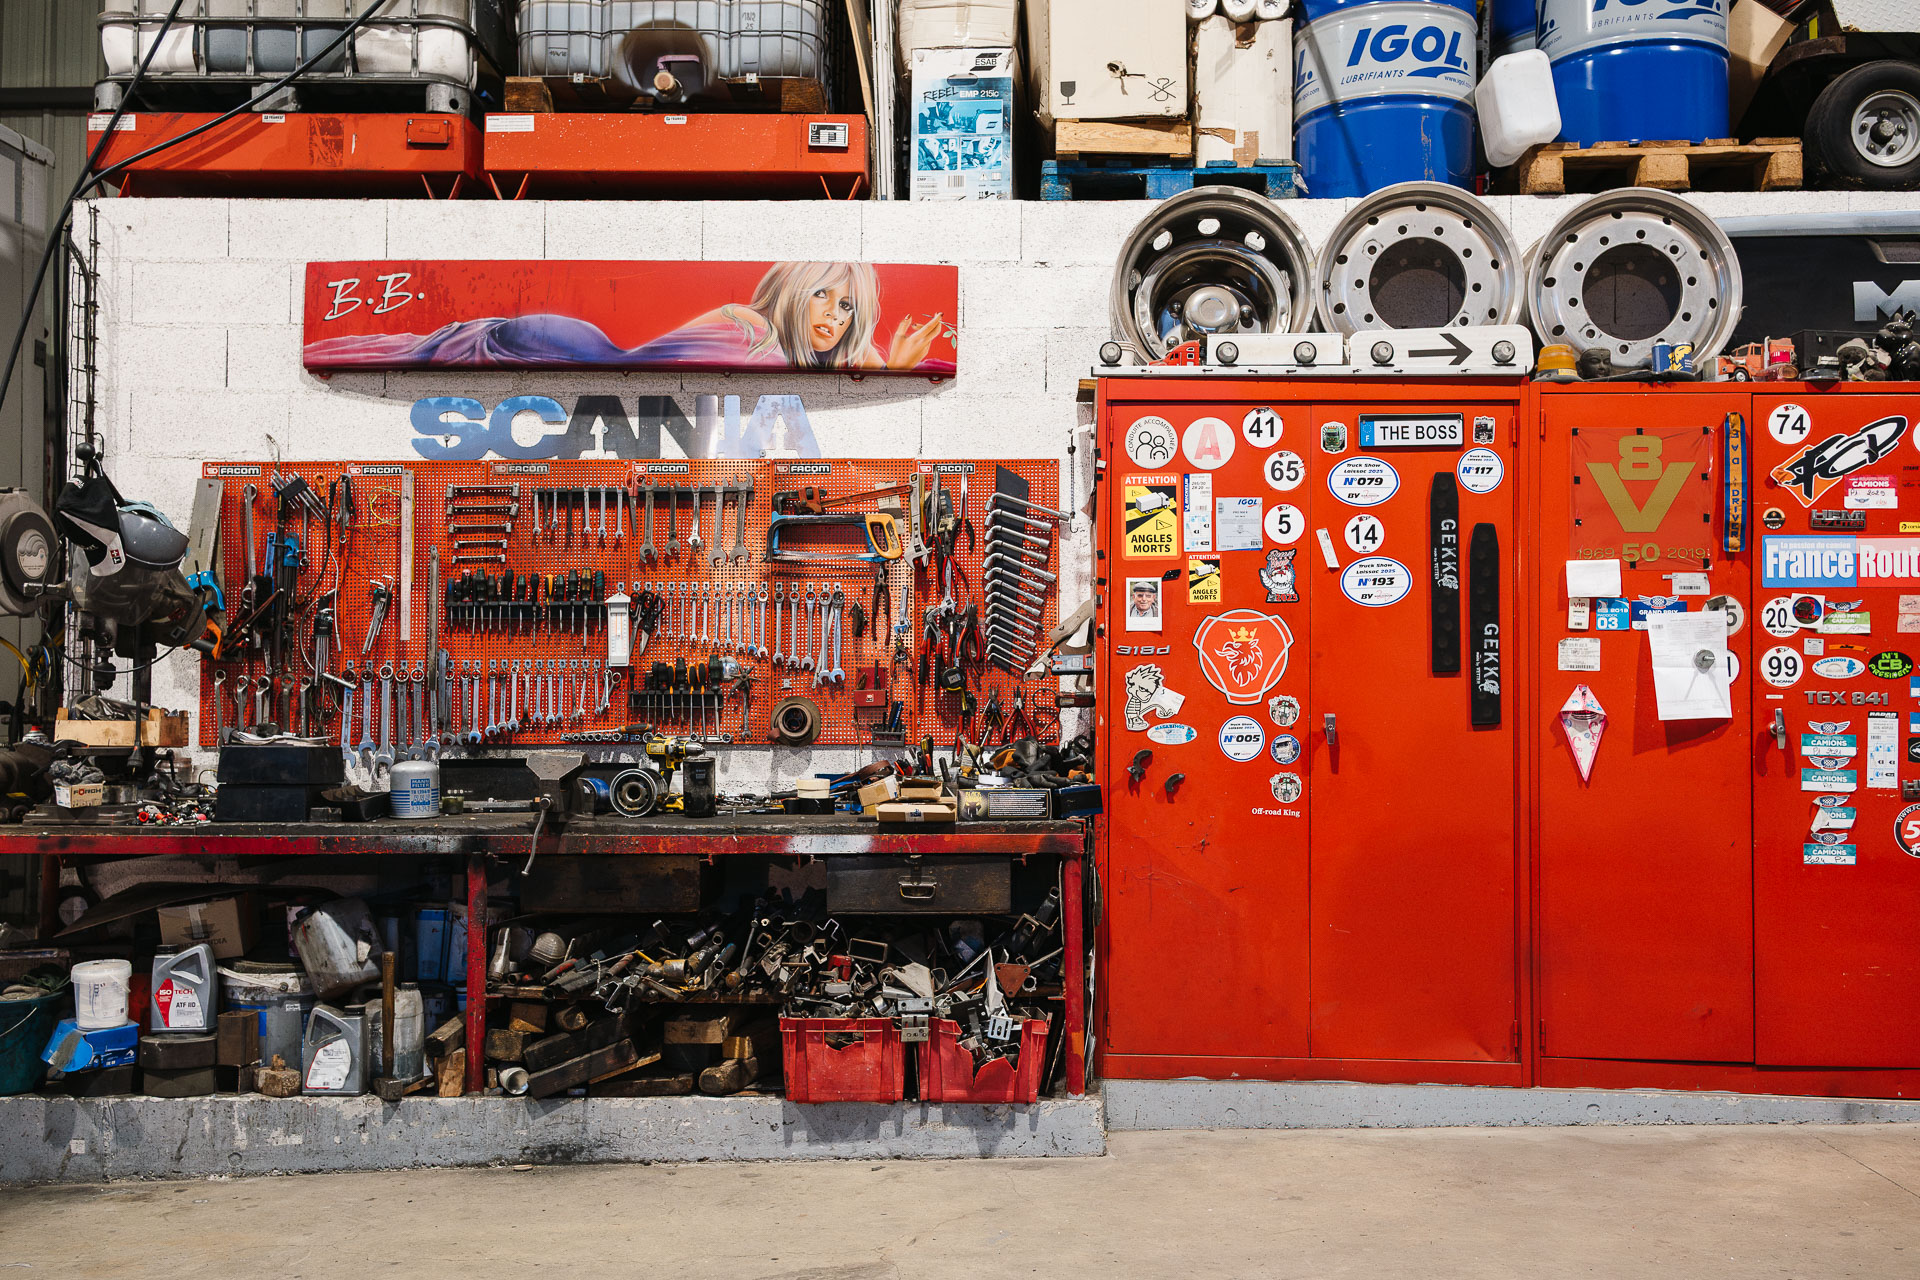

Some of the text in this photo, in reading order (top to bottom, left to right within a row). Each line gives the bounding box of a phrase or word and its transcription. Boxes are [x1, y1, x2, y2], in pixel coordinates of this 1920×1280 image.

[975, 58, 998, 66] ESAB
[1340, 69, 1405, 85] LUBRIFIANTS
[923, 86, 959, 103] REBEL
[959, 90, 979, 98] EMP
[410, 394, 822, 460] SCANIA
[1249, 416, 1275, 438] 41
[1776, 413, 1806, 435] 74
[1127, 422, 1142, 453] CONDUITE
[1380, 424, 1458, 441] THE BOSS
[1194, 424, 1222, 460] A
[219, 467, 261, 475] FACOM
[362, 466, 404, 474] FACOM
[508, 464, 549, 473] FACOM
[648, 465, 689, 473] FACOM
[790, 464, 831, 473] FACOM
[1270, 460, 1299, 482] 65
[1125, 475, 1177, 485] ATTENTION
[1851, 480, 1890, 488] CAMIONS
[1238, 498, 1258, 506] IGOL
[1731, 489, 1740, 538] DRIVER
[1811, 509, 1866, 520] HEMI
[1278, 513, 1292, 535] 5
[1131, 534, 1173, 543] ANGLES
[1350, 523, 1378, 545] 14
[1133, 544, 1171, 553] MORTS
[1576, 542, 1706, 562] 1969 50 2019
[1765, 544, 1855, 579] France
[1357, 577, 1395, 587] N°193
[1275, 593, 1298, 602] 2023
[1597, 617, 1619, 630] 03
[1765, 607, 1788, 629] 20
[1768, 655, 1798, 678] 99
[1868, 663, 1913, 679] PRESIDENT
[1877, 659, 1903, 671] CB
[1804, 691, 1889, 706] TGX 841
[1811, 739, 1848, 747] CAMIONS
[1811, 775, 1848, 783] CAMIONS
[1251, 807, 1301, 819] Off-road King
